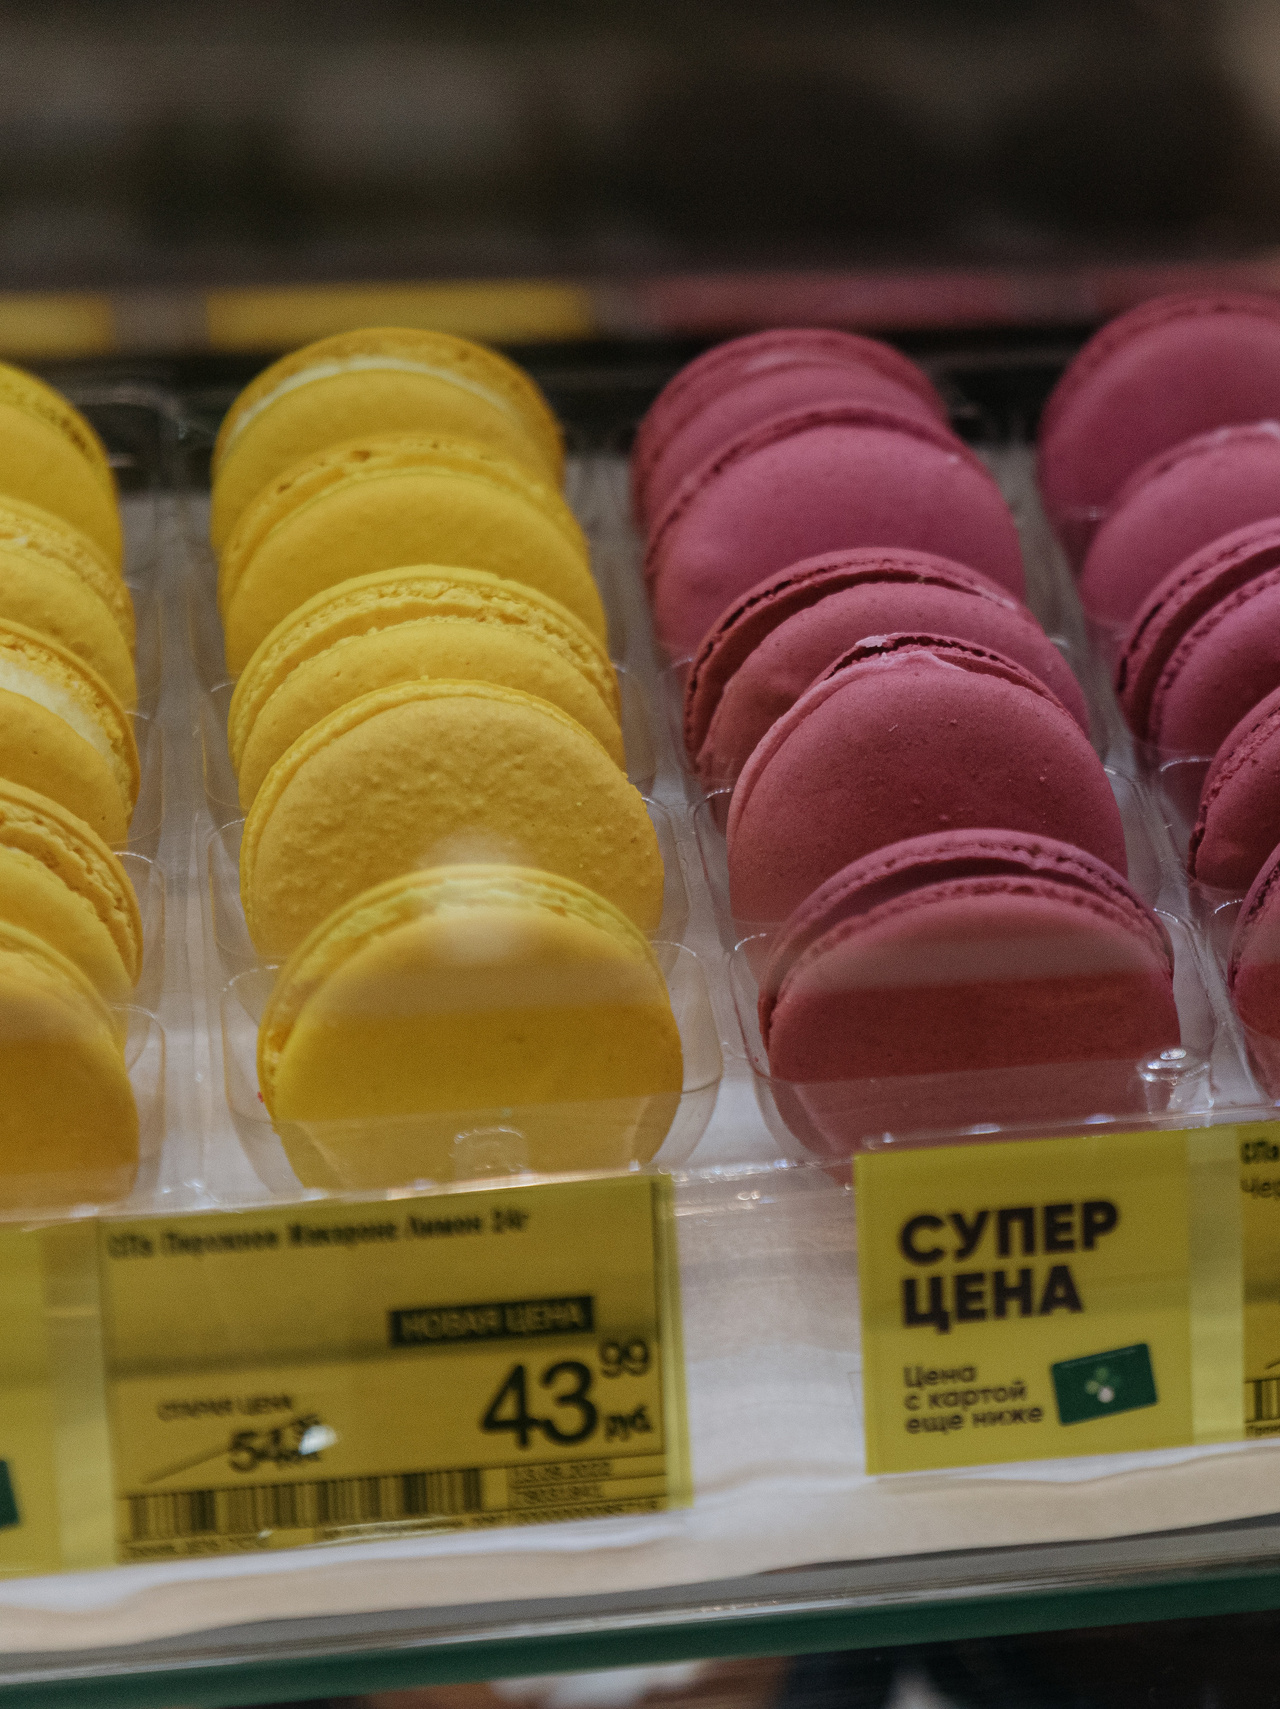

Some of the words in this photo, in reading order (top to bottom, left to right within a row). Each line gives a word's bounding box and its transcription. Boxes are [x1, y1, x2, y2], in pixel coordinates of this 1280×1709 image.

[900, 1200, 1120, 1268] СУПЕР
[903, 1265, 1084, 1336] ЦЕНА
[482, 1361, 598, 1450] 43
[600, 1339, 652, 1378] 99
[903, 1366, 978, 1389] Цена
[904, 1394, 920, 1411] с
[928, 1380, 1027, 1410] картой
[905, 1415, 964, 1434] еще
[972, 1407, 1044, 1427] ниже
